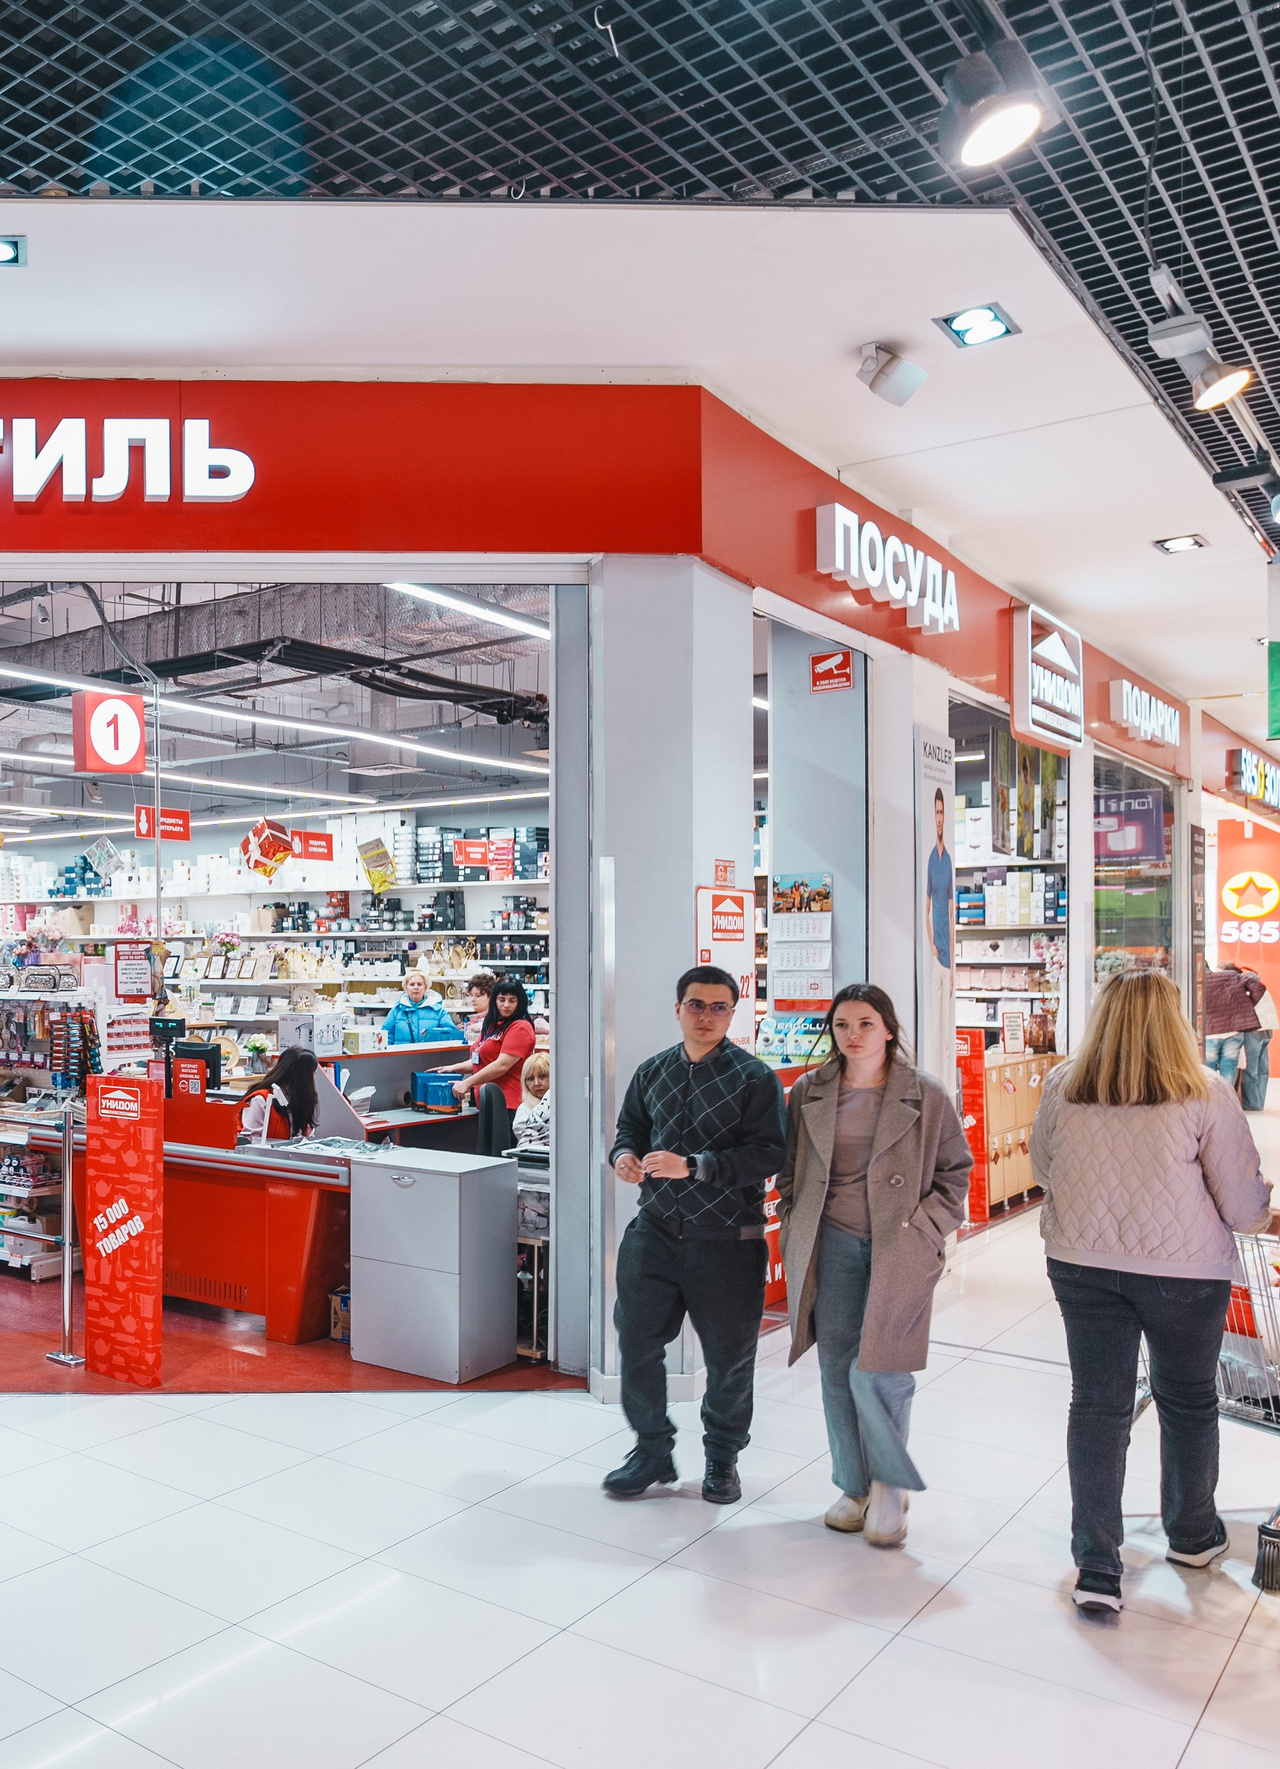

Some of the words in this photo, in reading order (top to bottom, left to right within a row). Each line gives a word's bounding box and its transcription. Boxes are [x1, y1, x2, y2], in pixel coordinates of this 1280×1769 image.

[832, 502, 960, 633] ПОСУДА
[1032, 662, 1082, 717] УНИДОМ
[1122, 679, 1180, 747] ПОДАРКИ
[106, 714, 120, 751] 1
[923, 741, 952, 766] KANZLER
[1241, 747, 1258, 796] 585
[713, 915, 743, 930] УНИДОМ
[1220, 921, 1280, 944] 585
[702, 951, 710, 960] ПН
[101, 1099, 138, 1111] УНИДОМ
[93, 1213, 108, 1233] 15
[106, 1198, 129, 1224] 000
[96, 1215, 145, 1257] ТОВАРОВ
